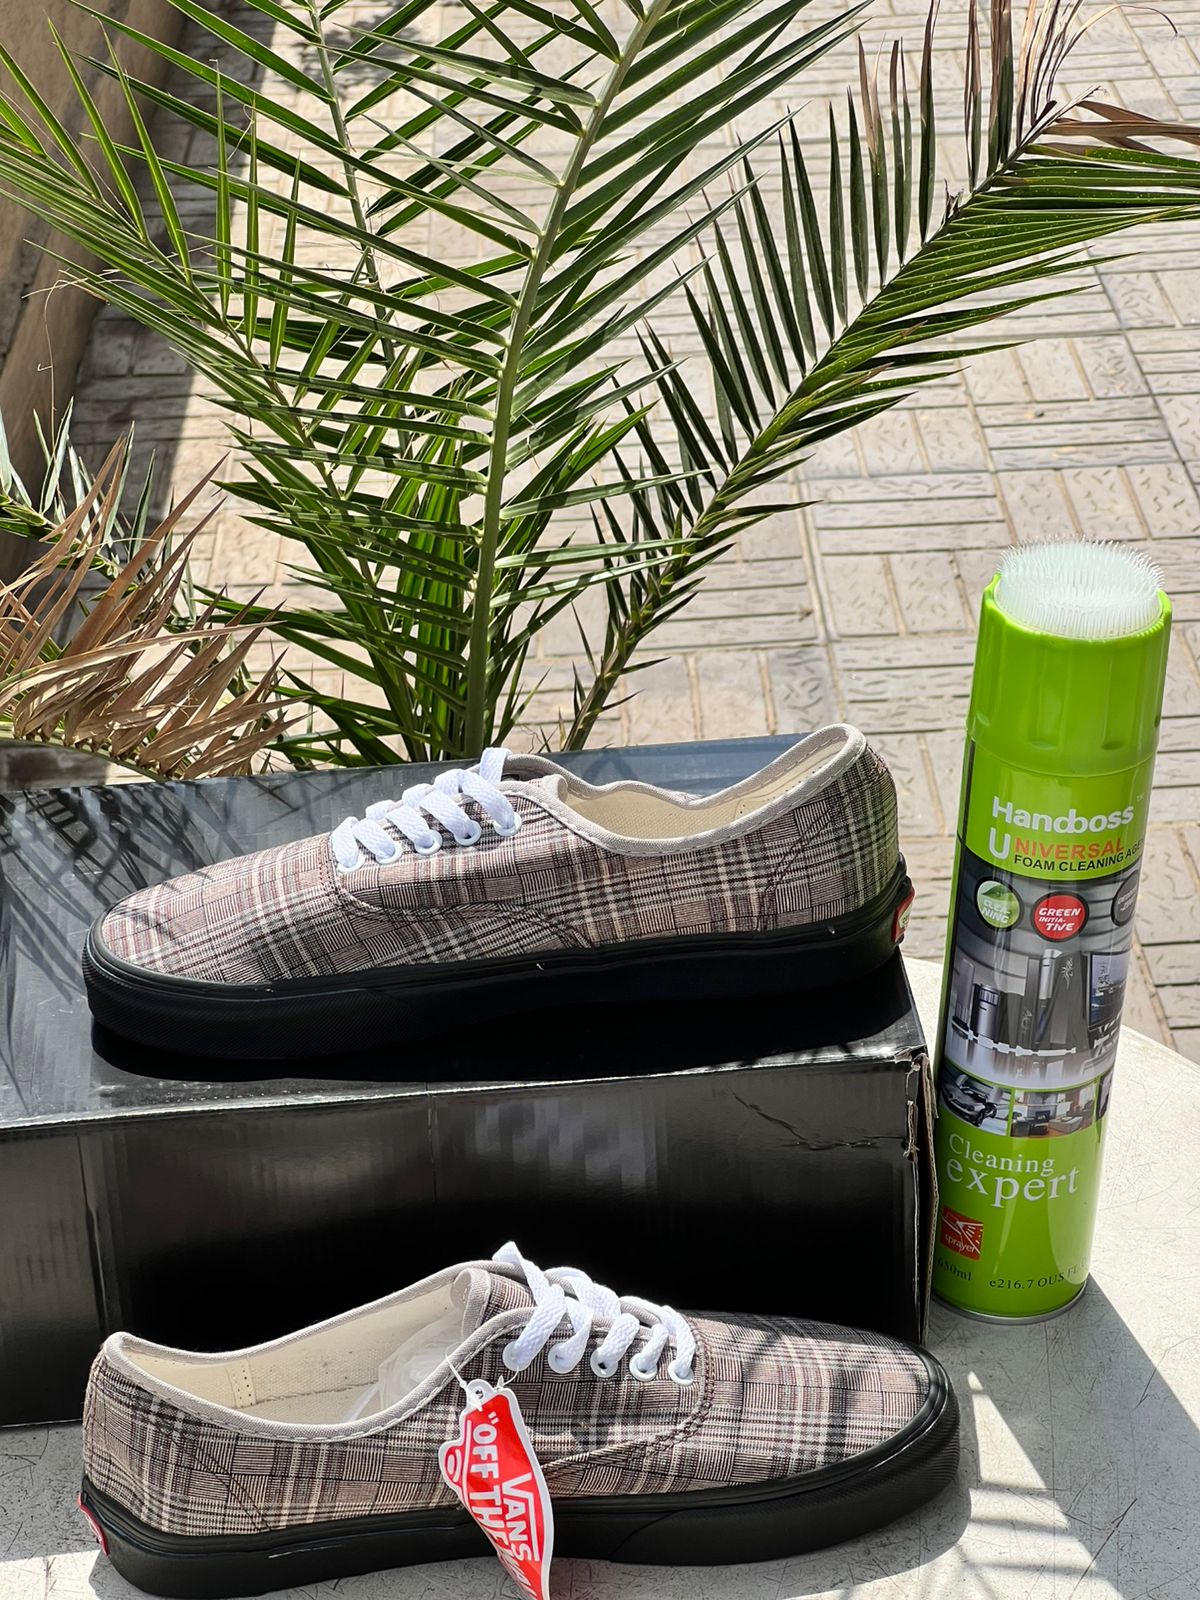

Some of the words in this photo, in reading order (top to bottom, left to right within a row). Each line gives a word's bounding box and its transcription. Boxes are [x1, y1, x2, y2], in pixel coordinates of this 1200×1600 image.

[992, 795, 1134, 835] Handboss
[988, 827, 1124, 860] UNIVERSAL
[1014, 854, 1055, 872] FOAM
[1059, 849, 1124, 872] CLEANING
[982, 908, 1009, 924] NING
[1038, 907, 1082, 917] GREEN
[1045, 922, 1076, 932] TIVE
[948, 1132, 1055, 1177] Cleaning
[946, 1156, 1080, 1209] expert
[944, 1233, 975, 1253] sprayer
[470, 1411, 500, 1480] "OFF
[502, 1472, 541, 1562] VANS
